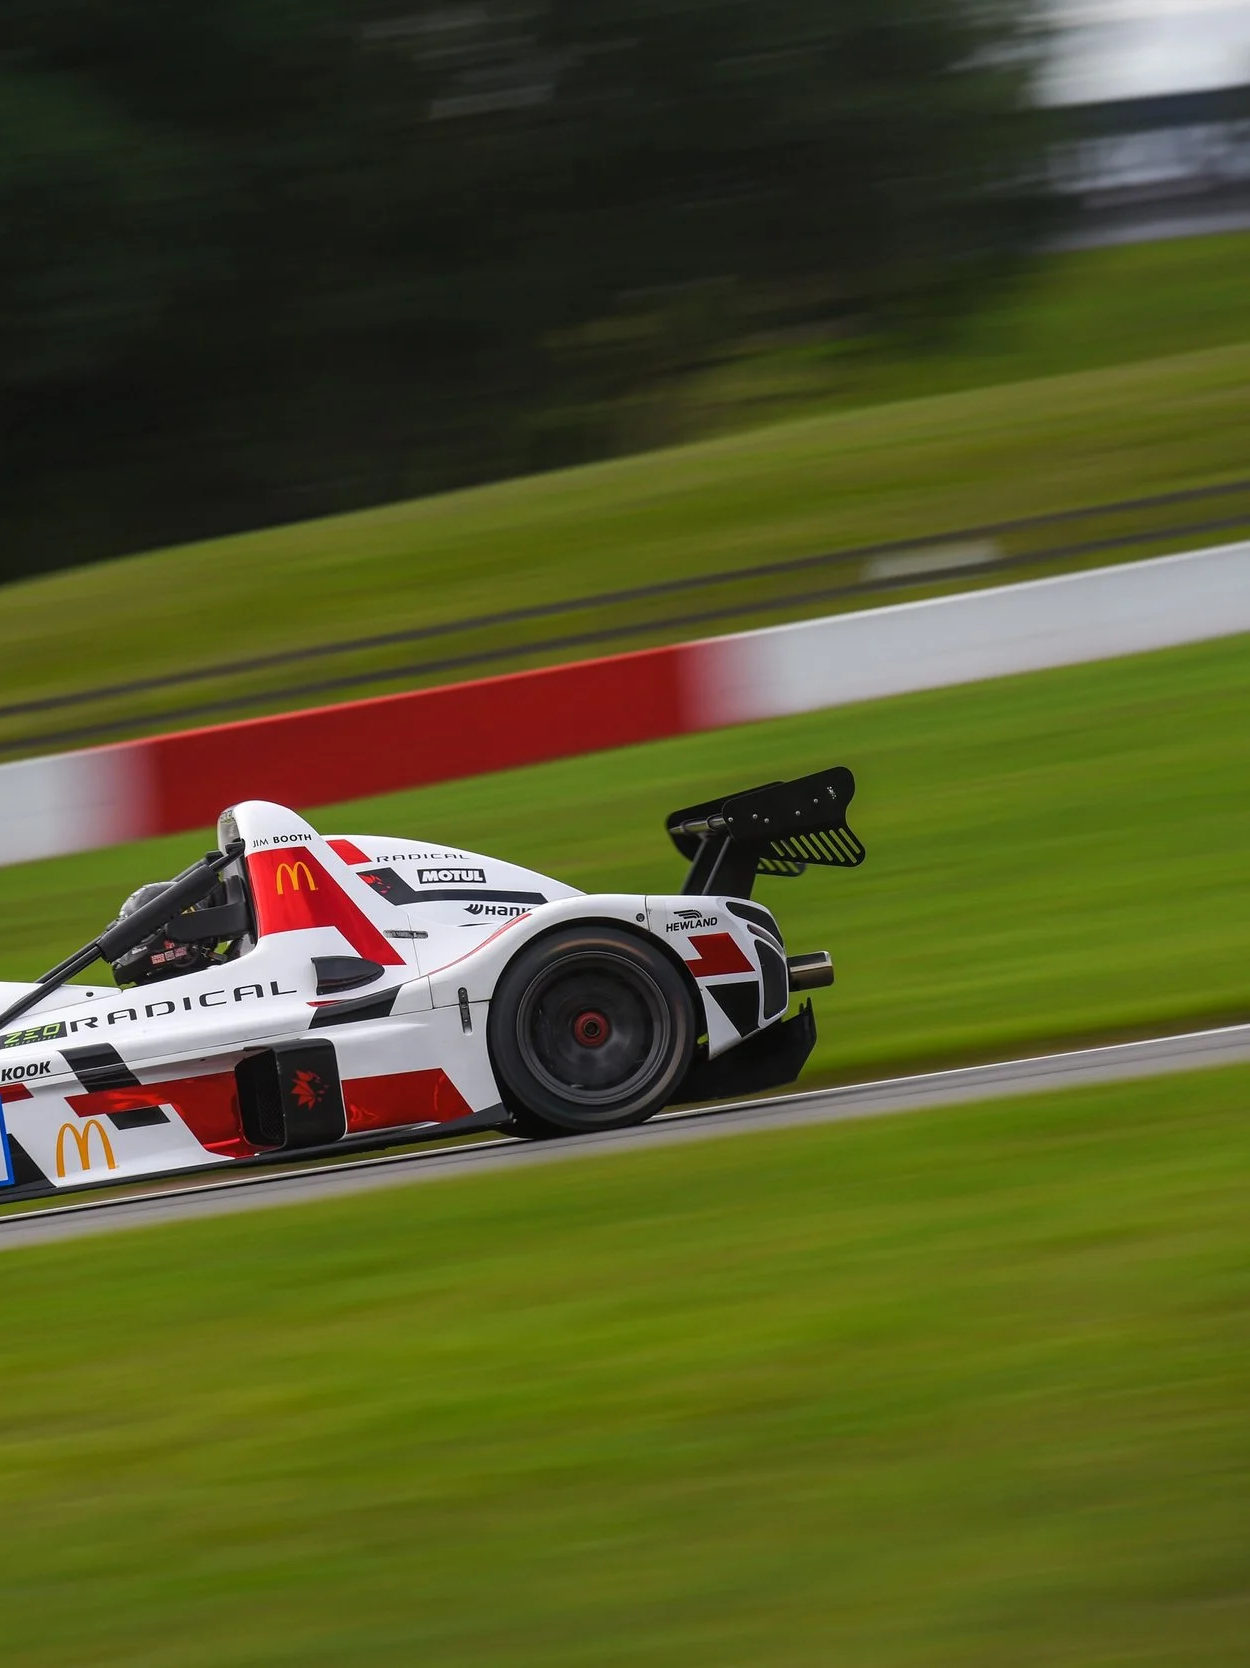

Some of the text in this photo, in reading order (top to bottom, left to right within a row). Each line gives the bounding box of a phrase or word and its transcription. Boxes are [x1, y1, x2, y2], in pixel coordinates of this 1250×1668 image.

[252, 834, 312, 848] JIM BOOTH
[376, 853, 471, 863] RADICAL
[421, 869, 484, 882] MOTUL
[665, 917, 718, 932] HEWLAND
[69, 981, 298, 1033] RADICAL
